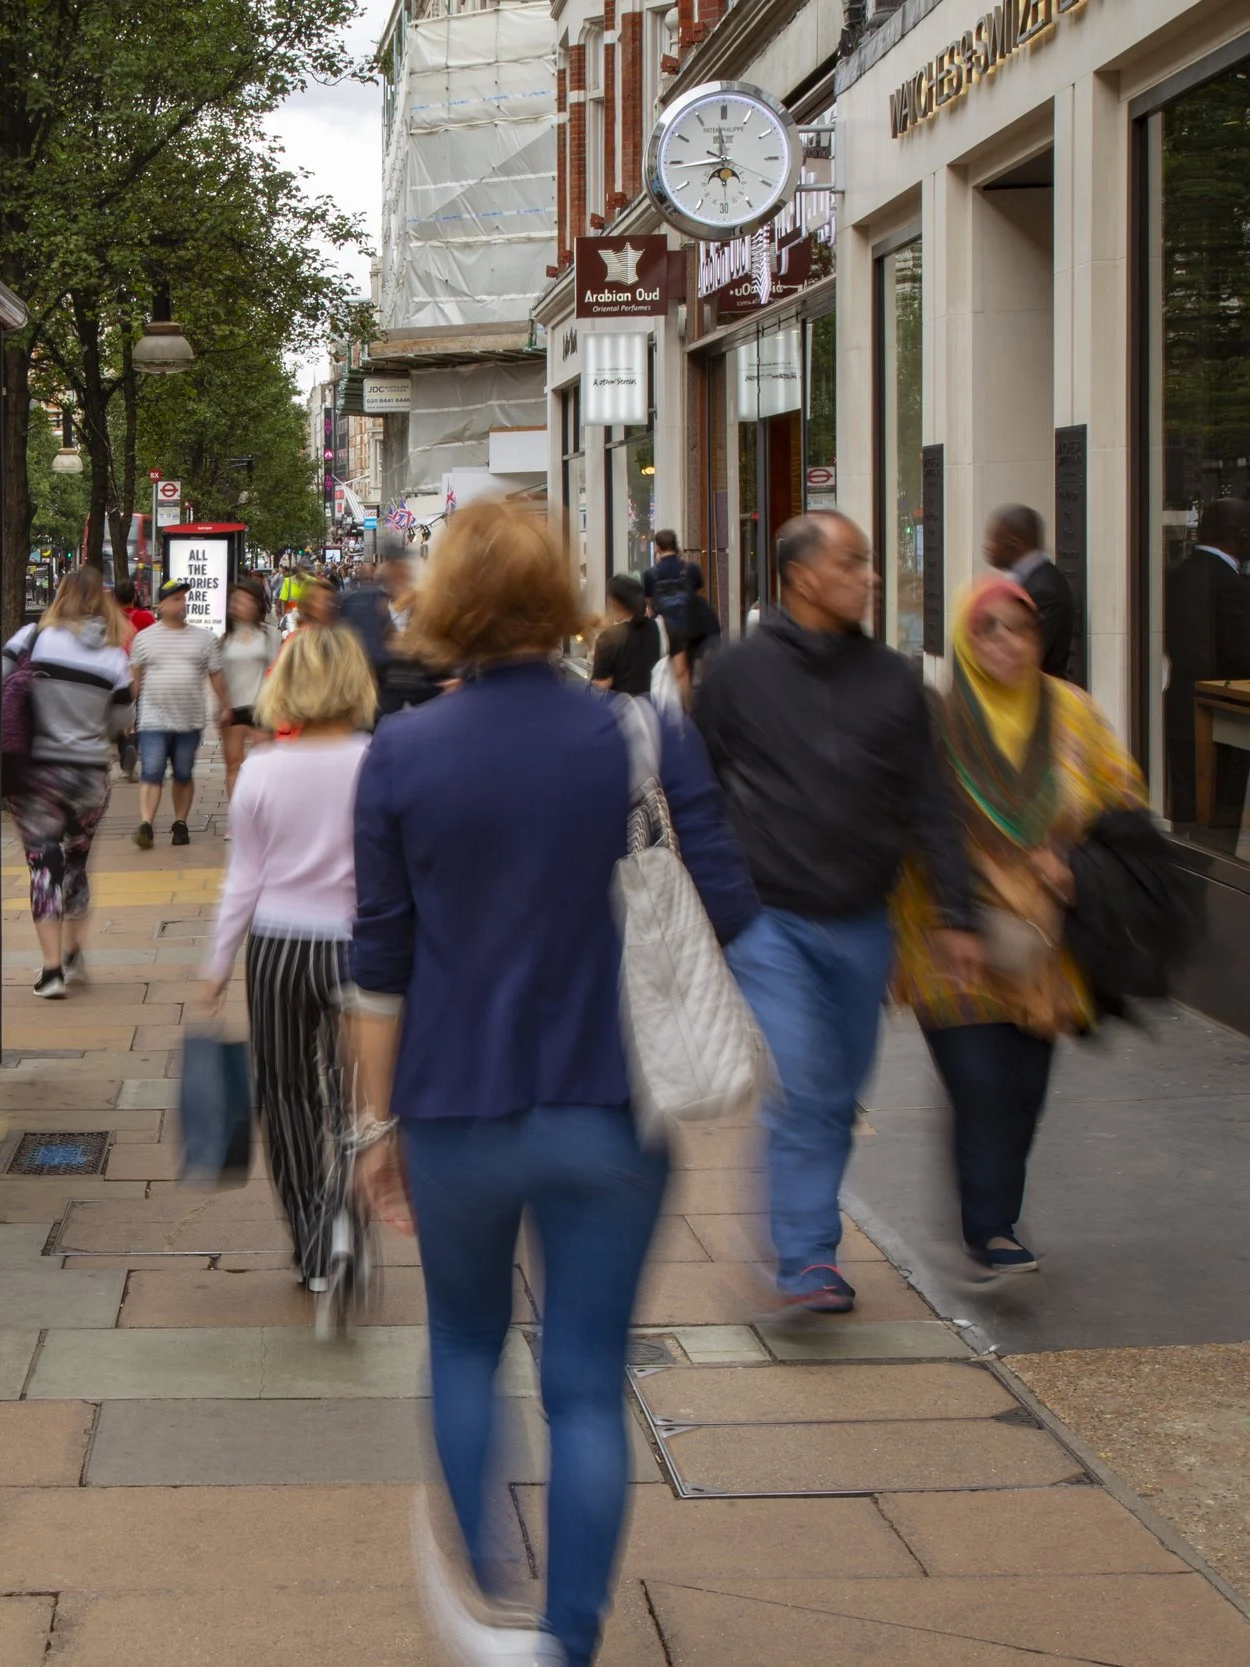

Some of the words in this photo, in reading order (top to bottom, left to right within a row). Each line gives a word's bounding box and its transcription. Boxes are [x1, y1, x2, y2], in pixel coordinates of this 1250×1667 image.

[889, 40, 963, 139] WATCHES
[719, 202, 729, 214] 30
[584, 288, 632, 303] Arabian
[636, 287, 660, 301] Oud
[592, 304, 620, 313] Oriental
[620, 304, 651, 312] Perfumes
[367, 385, 384, 394] JDC
[189, 549, 208, 561] ALL
[187, 564, 207, 575] THE
[187, 591, 208, 602] ARE
[186, 603, 210, 615] TRUE
